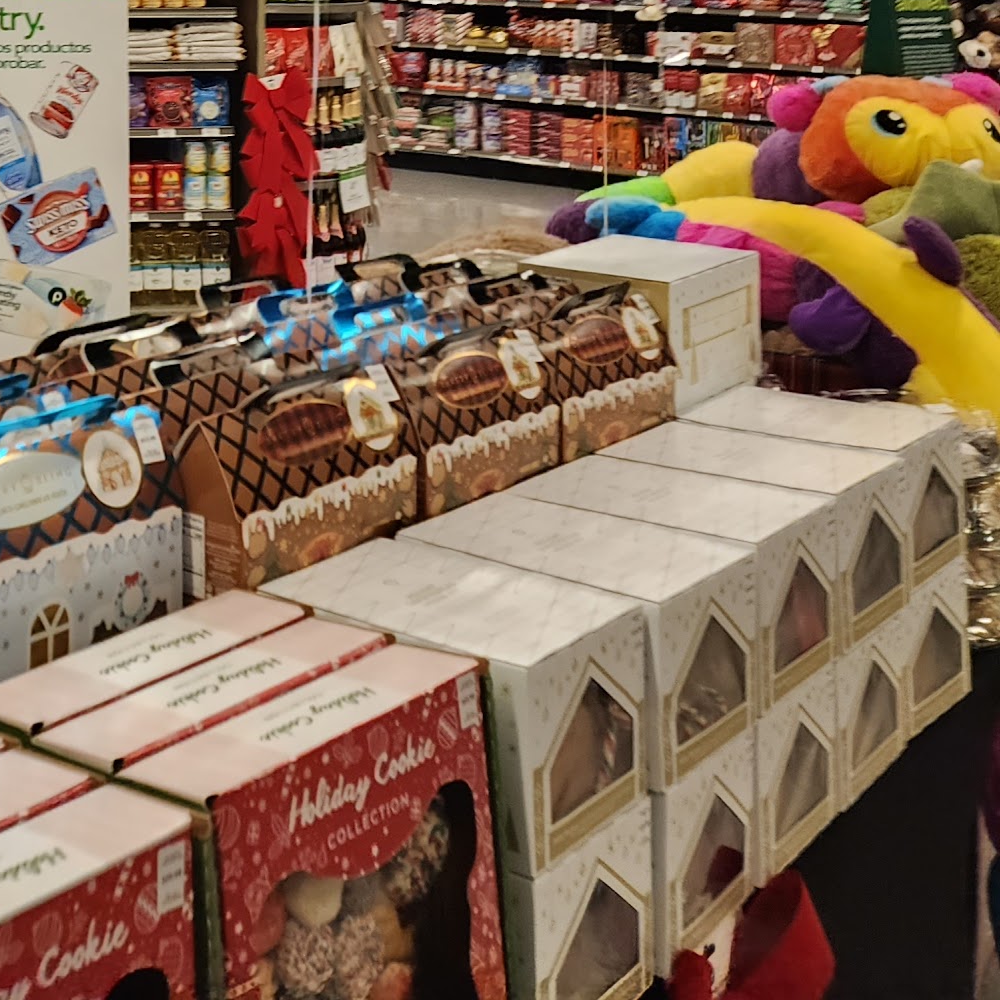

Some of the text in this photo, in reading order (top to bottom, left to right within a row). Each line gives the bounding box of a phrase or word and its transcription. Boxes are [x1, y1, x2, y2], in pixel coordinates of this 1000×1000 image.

[14, 40, 92, 58] productos
[48, 219, 78, 236] KETO
[288, 733, 436, 834] Holiday Cookie
[327, 792, 410, 851] COLLECTION
[36, 918, 129, 988] Cookie
